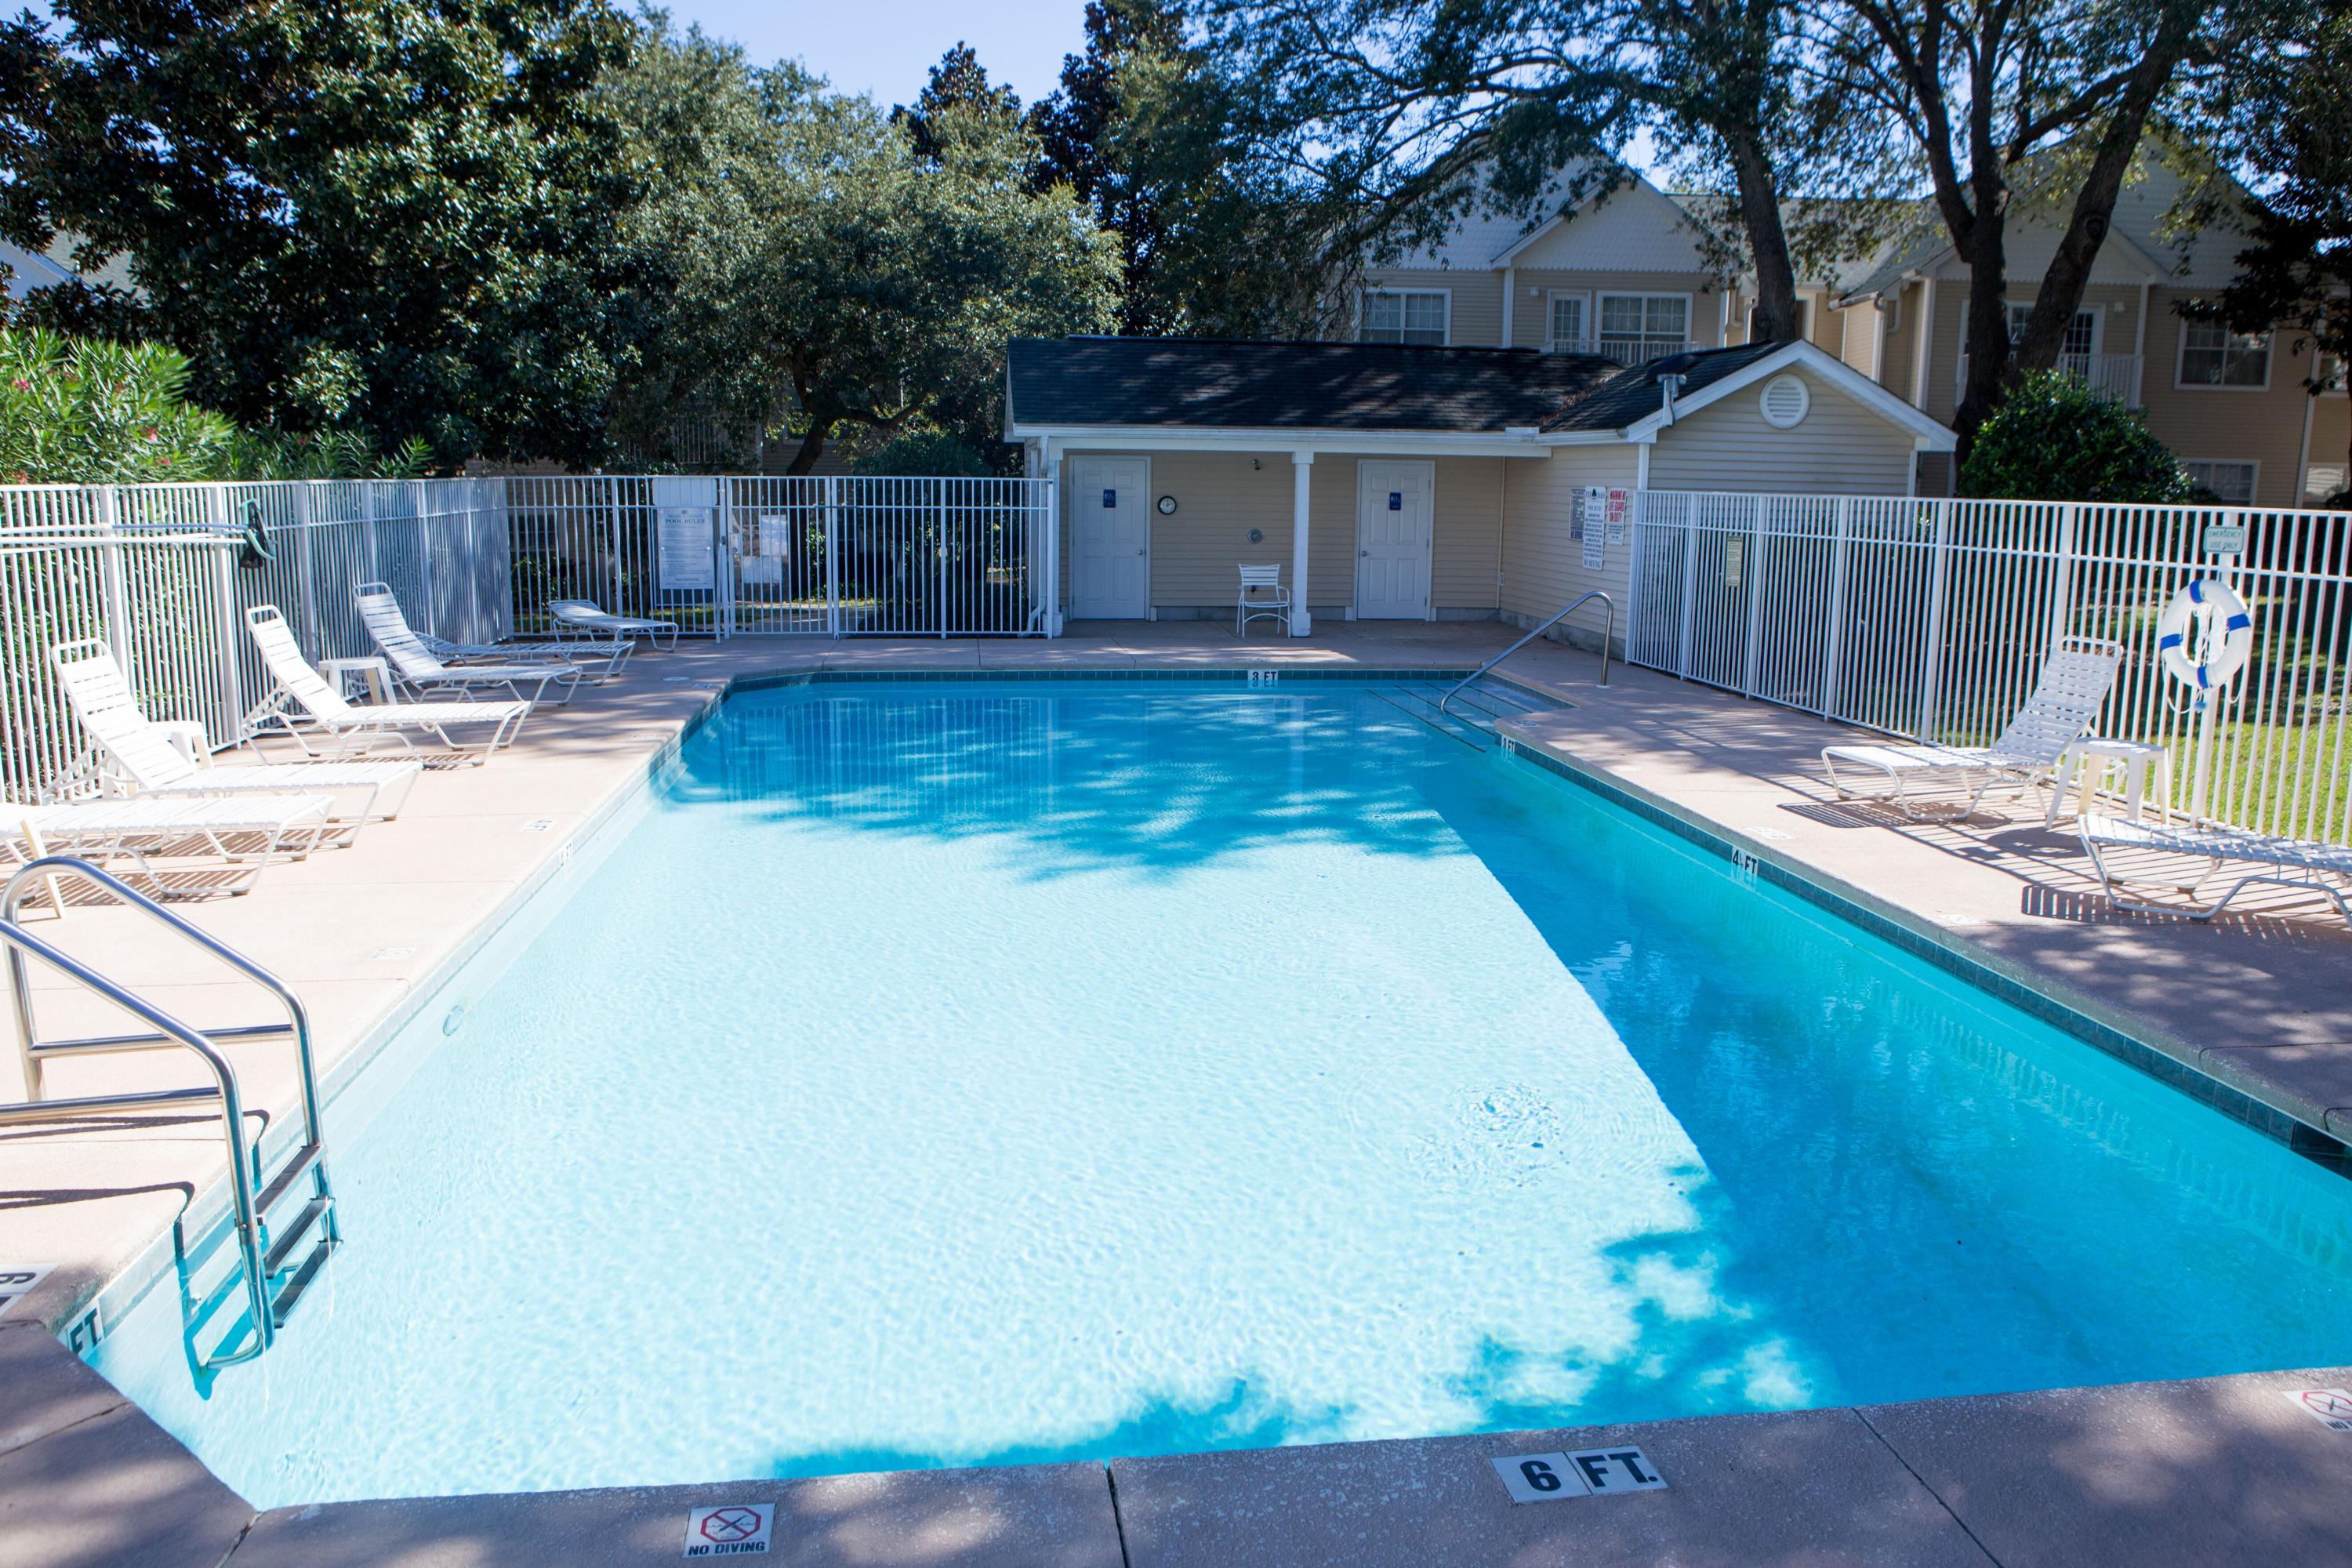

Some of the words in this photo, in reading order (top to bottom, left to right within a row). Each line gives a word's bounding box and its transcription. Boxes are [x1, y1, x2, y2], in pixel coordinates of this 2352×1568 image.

[1252, 671, 1259, 681] 3
[1264, 671, 1277, 681] FT
[1744, 855, 1757, 874] FT
[1519, 1460, 1562, 1492] 6
[688, 1544, 710, 1556] NO
[714, 1541, 765, 1554] DIVING
